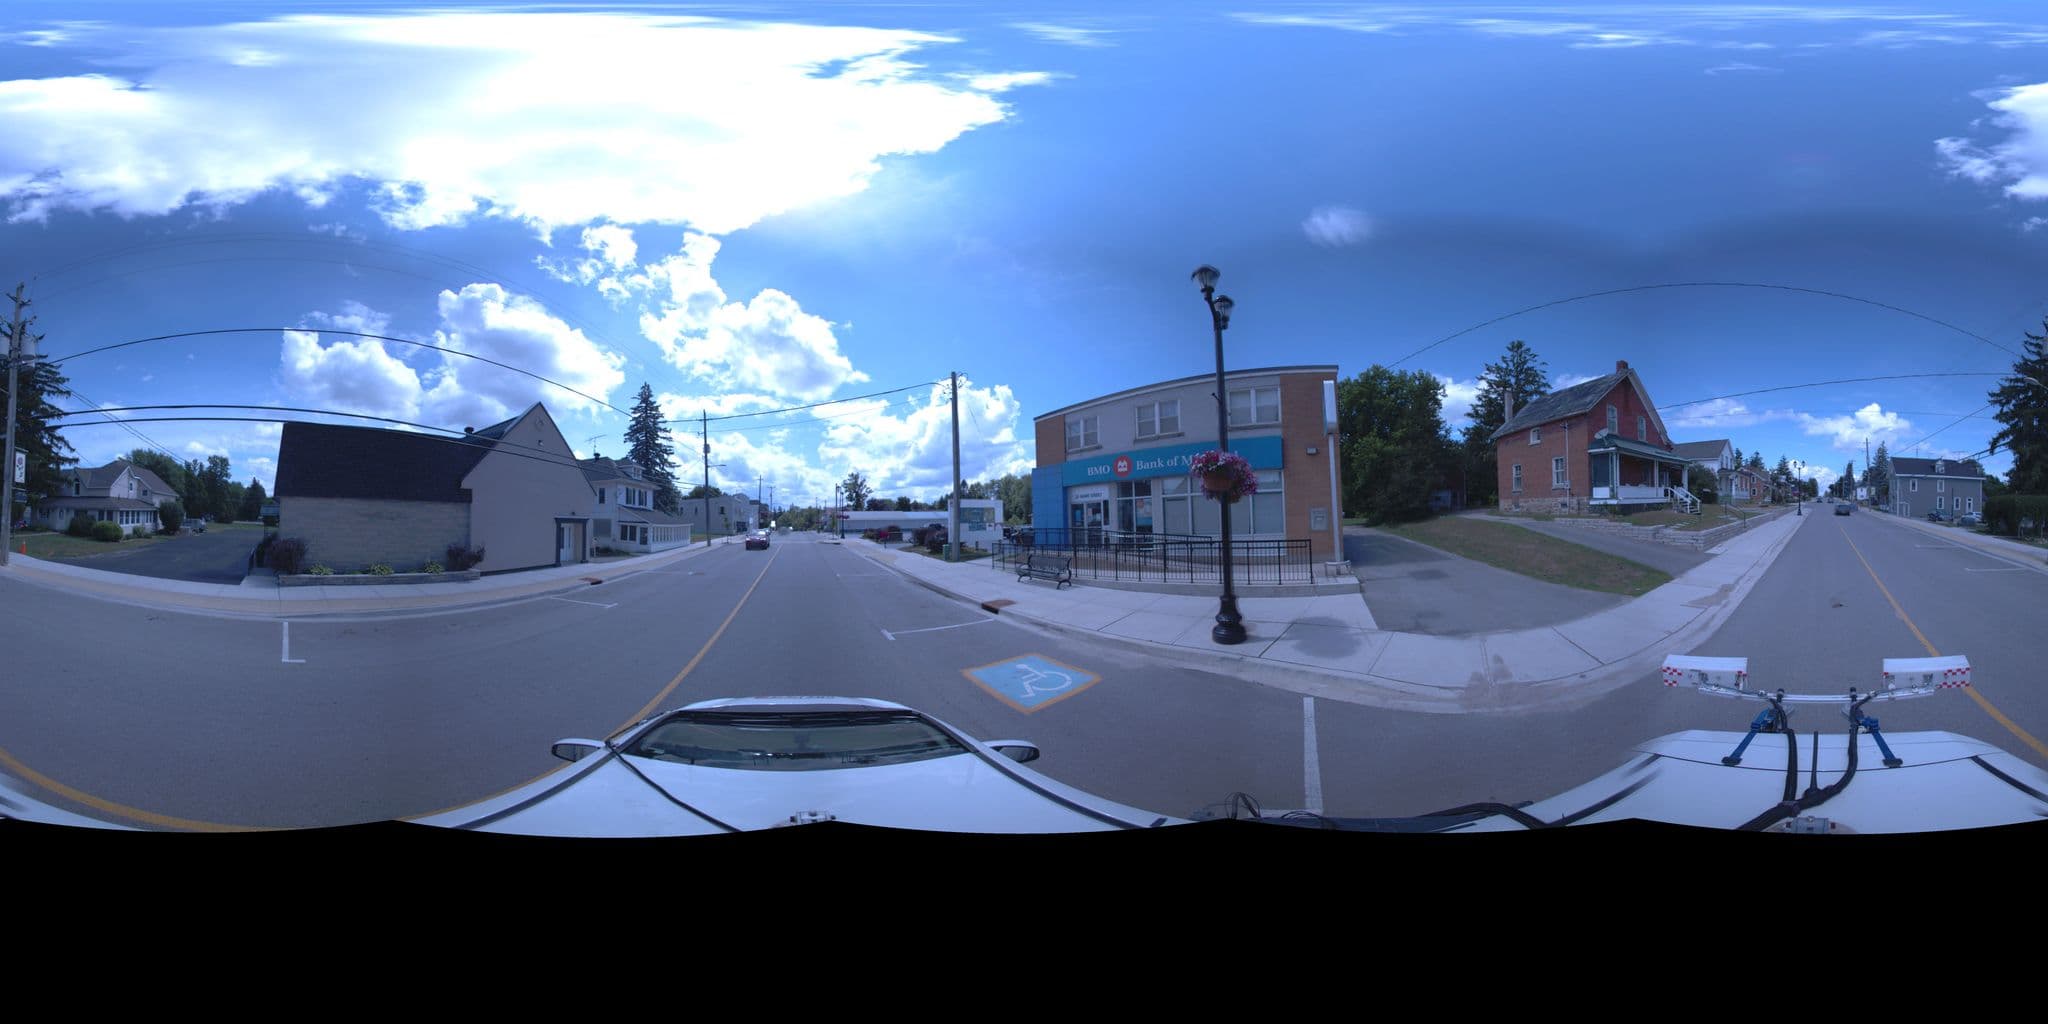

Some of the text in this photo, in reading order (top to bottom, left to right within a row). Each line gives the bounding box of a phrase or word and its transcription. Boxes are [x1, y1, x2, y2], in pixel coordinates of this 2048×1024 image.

[1087, 464, 1110, 476] BMO
[1136, 457, 1164, 470] Bank
[1166, 456, 1179, 467] of
